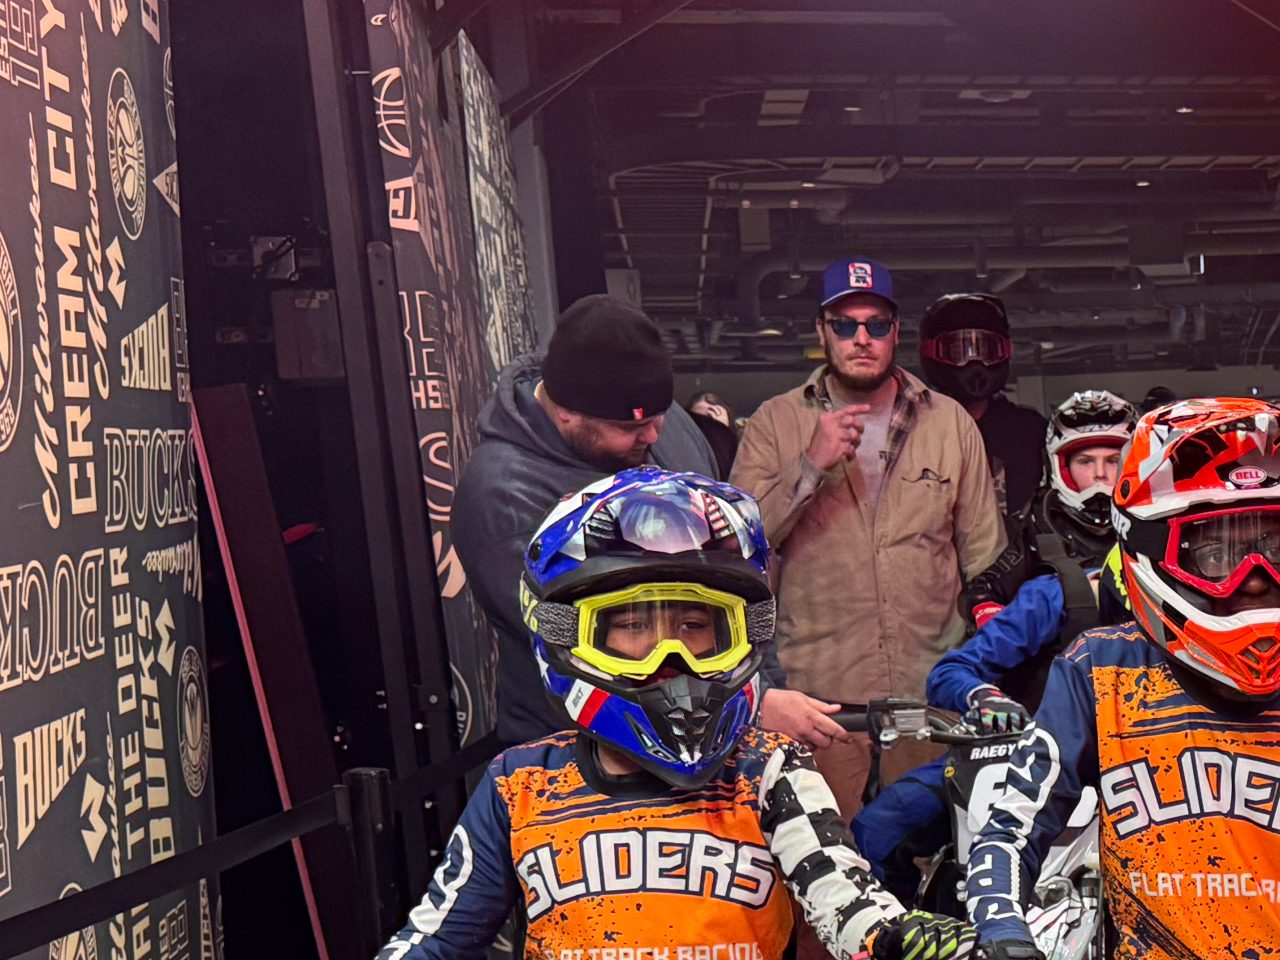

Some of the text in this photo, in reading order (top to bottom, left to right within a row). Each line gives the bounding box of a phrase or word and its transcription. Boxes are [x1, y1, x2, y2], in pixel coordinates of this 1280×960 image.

[39, 0, 97, 515] CREAM CITY
[80, 12, 110, 400] Milwaukee
[28, 112, 60, 529] Milwaukee
[120, 302, 172, 391] BUCKS
[1235, 471, 1262, 480] BELL
[0, 548, 104, 692] BUCK
[110, 545, 138, 716] DEER
[13, 707, 87, 851] BUCKS
[120, 731, 145, 861] THE
[135, 596, 176, 865] BUCKS
[516, 828, 777, 922] SLIDERS
[1129, 872, 1184, 897] FLAT
[1191, 872, 1263, 897] TRAC
